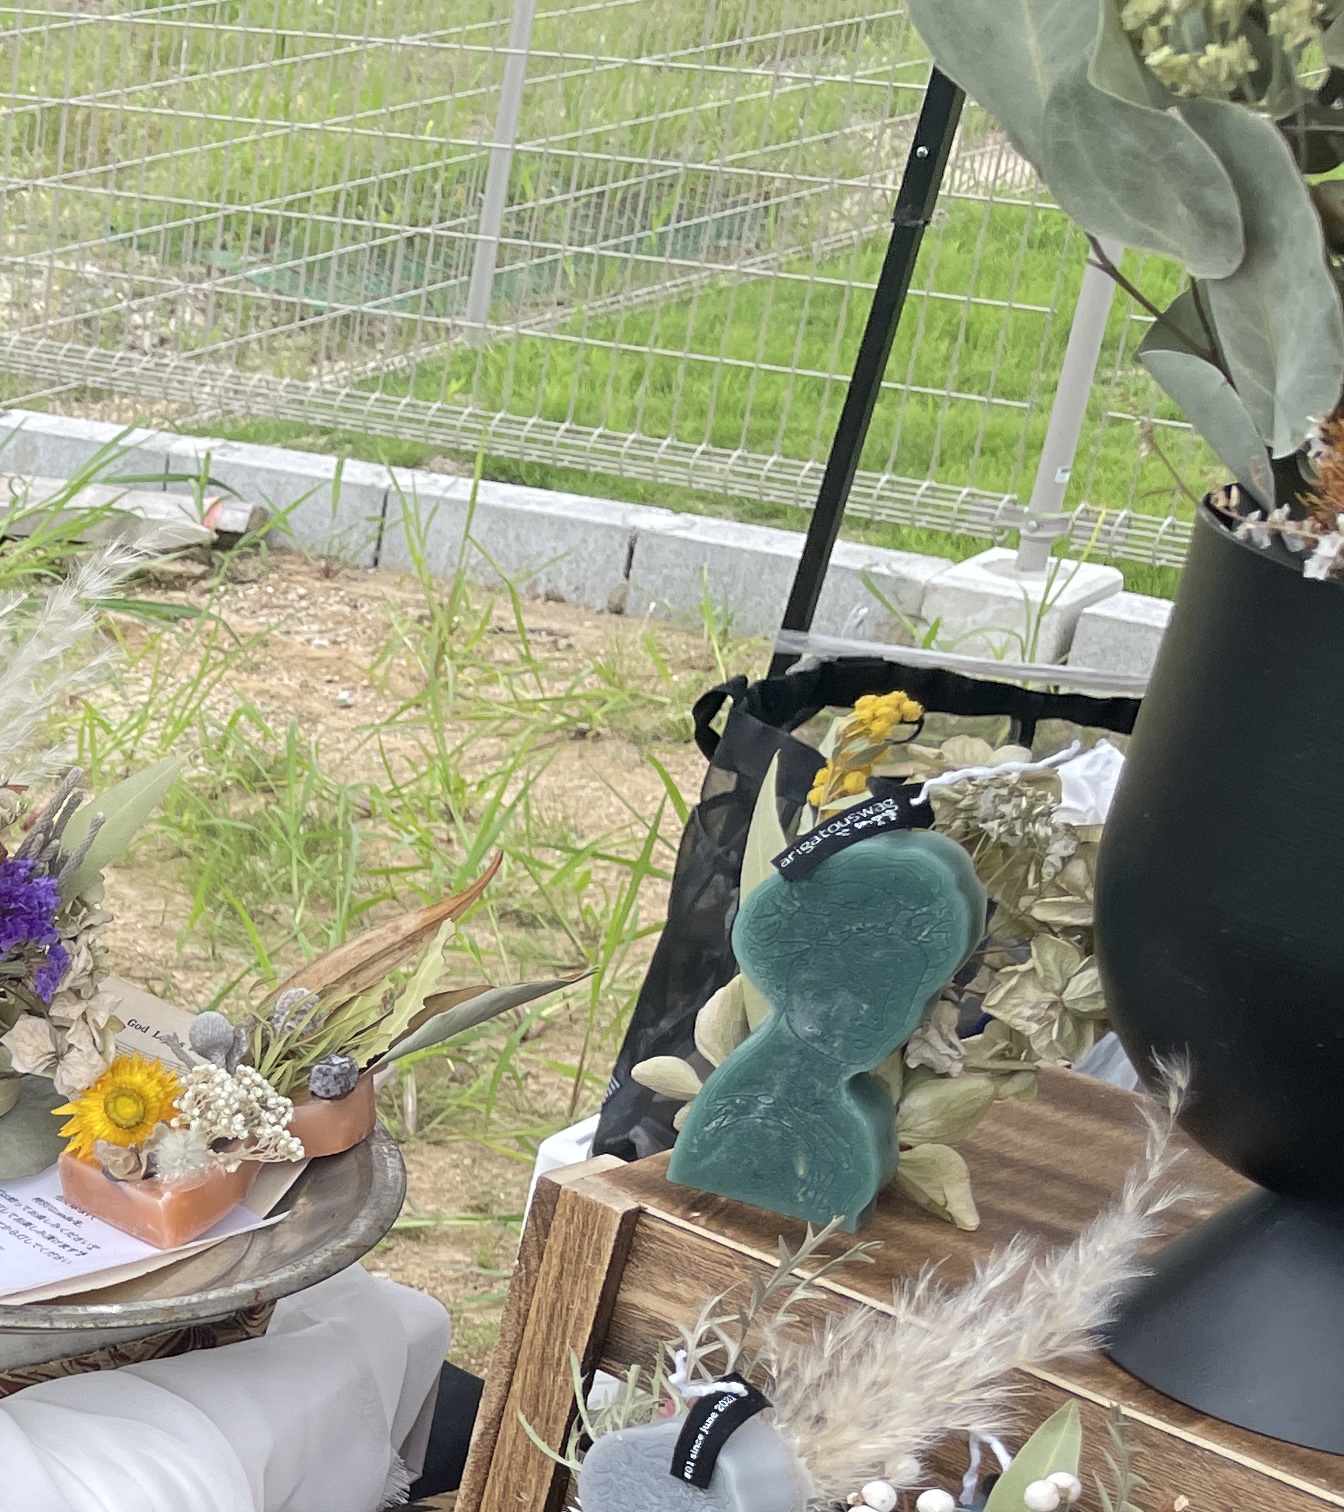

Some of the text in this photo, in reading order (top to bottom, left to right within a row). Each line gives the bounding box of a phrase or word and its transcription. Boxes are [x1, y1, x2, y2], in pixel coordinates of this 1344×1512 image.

[779, 798, 899, 868] arigatouswag
[689, 1433, 705, 1460] since
[698, 1410, 719, 1435] june
